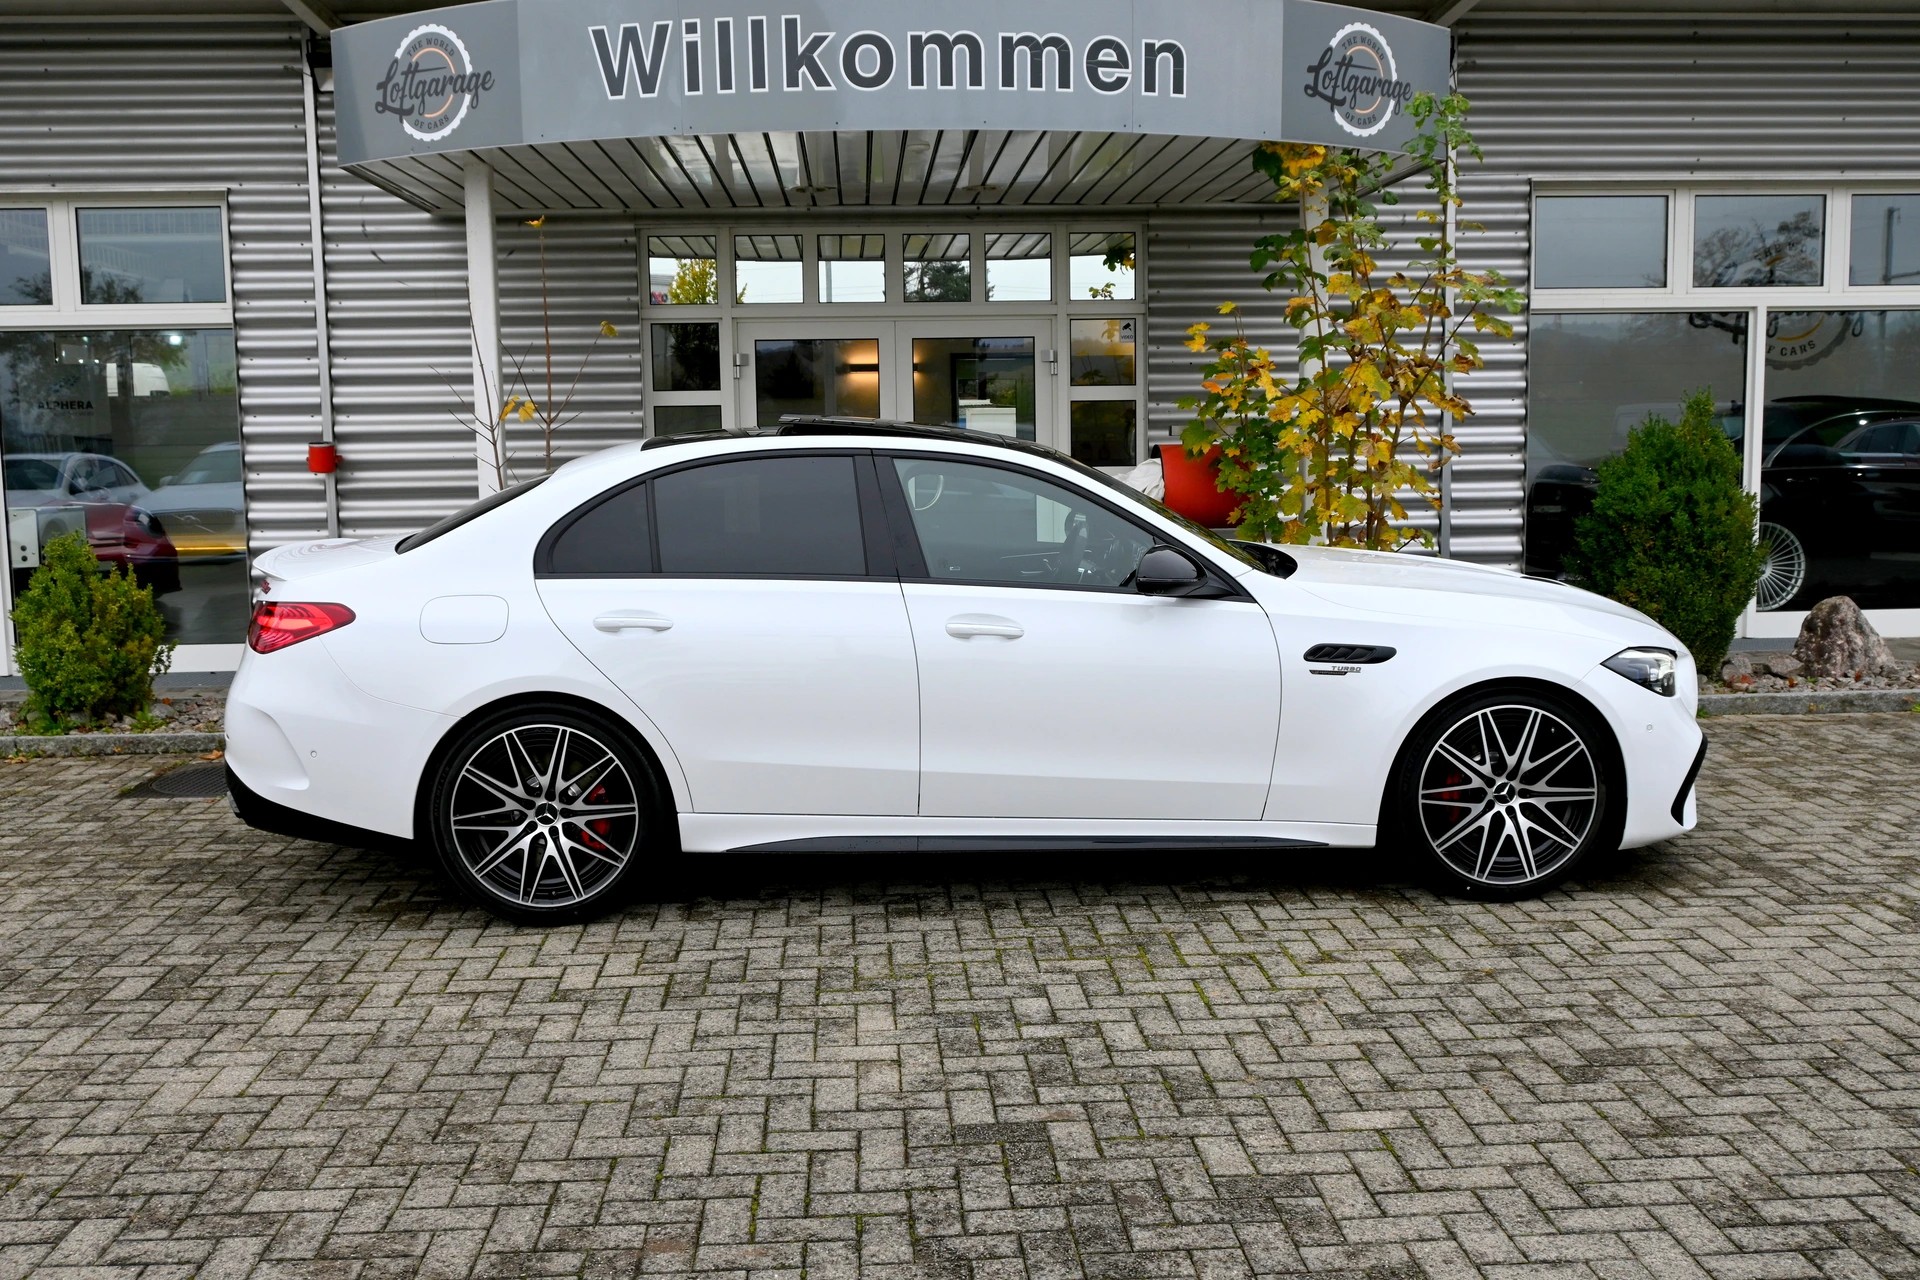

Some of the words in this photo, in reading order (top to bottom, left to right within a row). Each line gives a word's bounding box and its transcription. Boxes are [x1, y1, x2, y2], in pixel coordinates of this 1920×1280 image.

[407, 40, 423, 57] THE
[426, 38, 455, 57] WORLD
[588, 14, 1187, 99] Willkommen
[1342, 36, 1358, 50] THE
[1360, 36, 1385, 61] WORLD
[375, 57, 495, 123] Loftgarage
[1304, 46, 1413, 115] Loftgarage
[413, 119, 425, 129] OF
[427, 115, 449, 130] CARS
[1345, 111, 1355, 124] OF
[1357, 114, 1377, 125] CARS
[1779, 340, 1816, 357] CARS
[38, 400, 94, 410] ALPHERA
